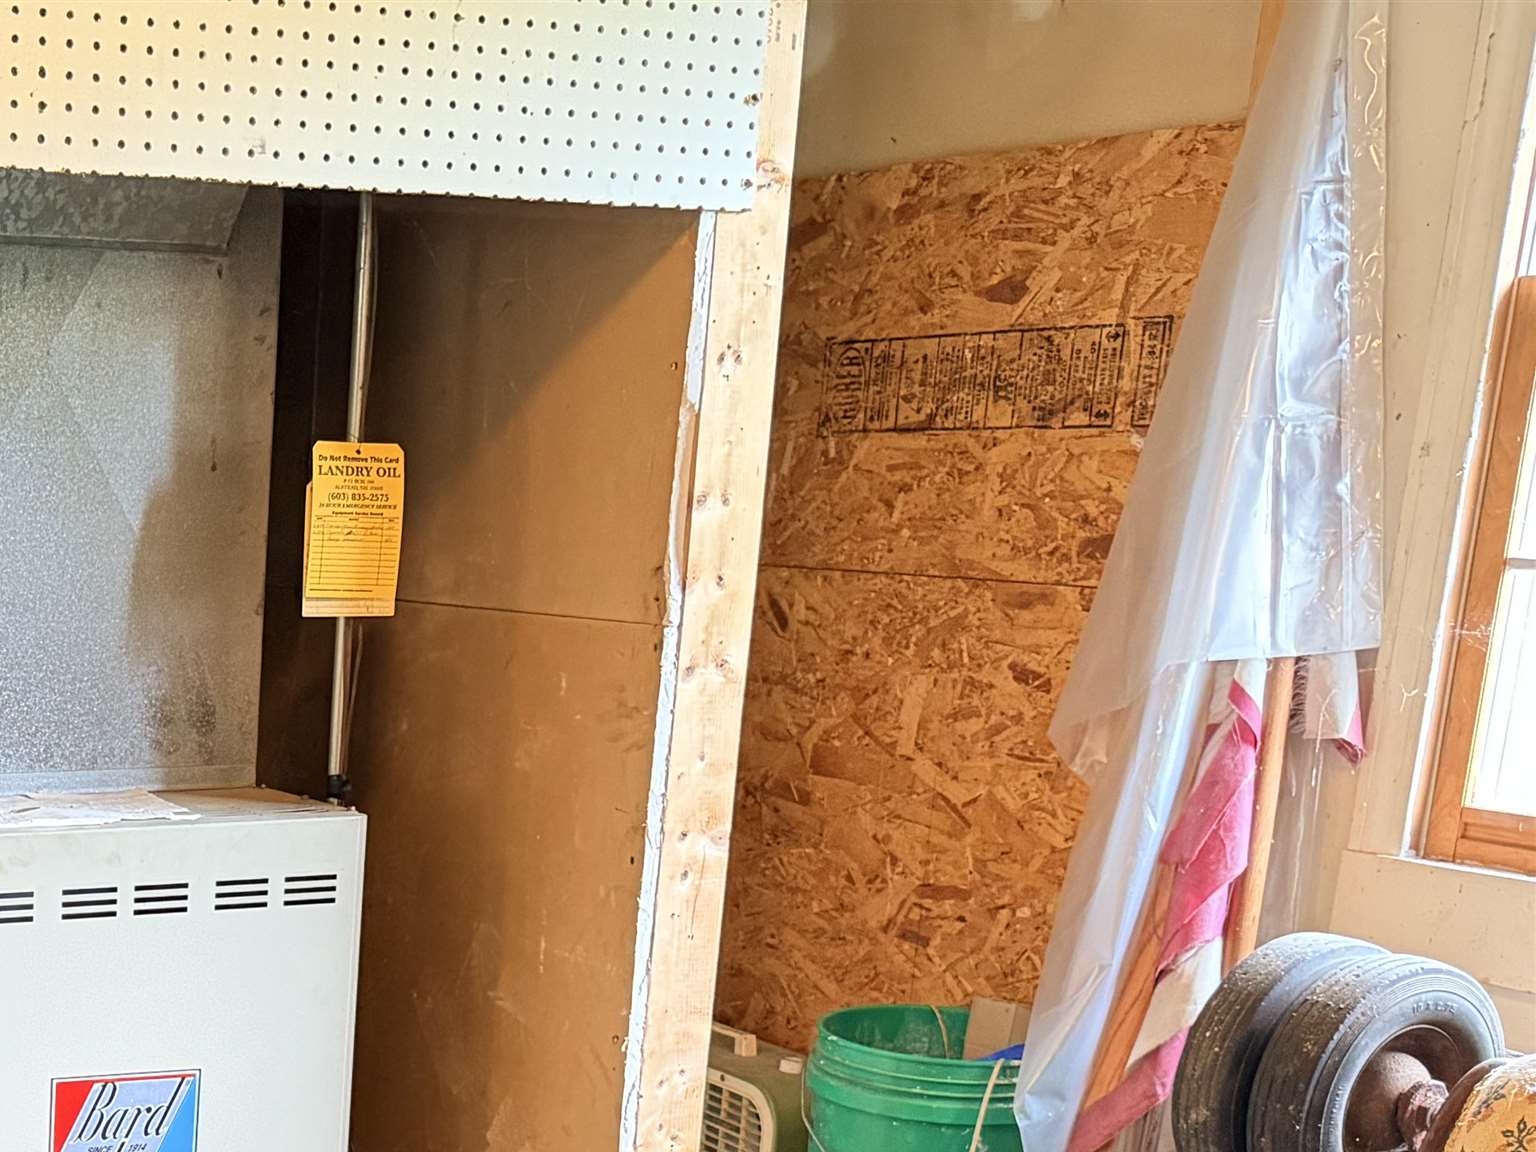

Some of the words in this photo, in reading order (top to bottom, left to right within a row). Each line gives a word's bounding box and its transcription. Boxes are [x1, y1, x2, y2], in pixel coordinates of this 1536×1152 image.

[318, 454, 328, 462] Do
[343, 455, 368, 463] Remove
[318, 465, 373, 478] LANDRY
[376, 467, 401, 478] OIL
[328, 492, 349, 502] (603)
[351, 493, 389, 502] 835-2575
[73, 1076, 186, 1143] Bard
[128, 1143, 147, 1152] 1914
